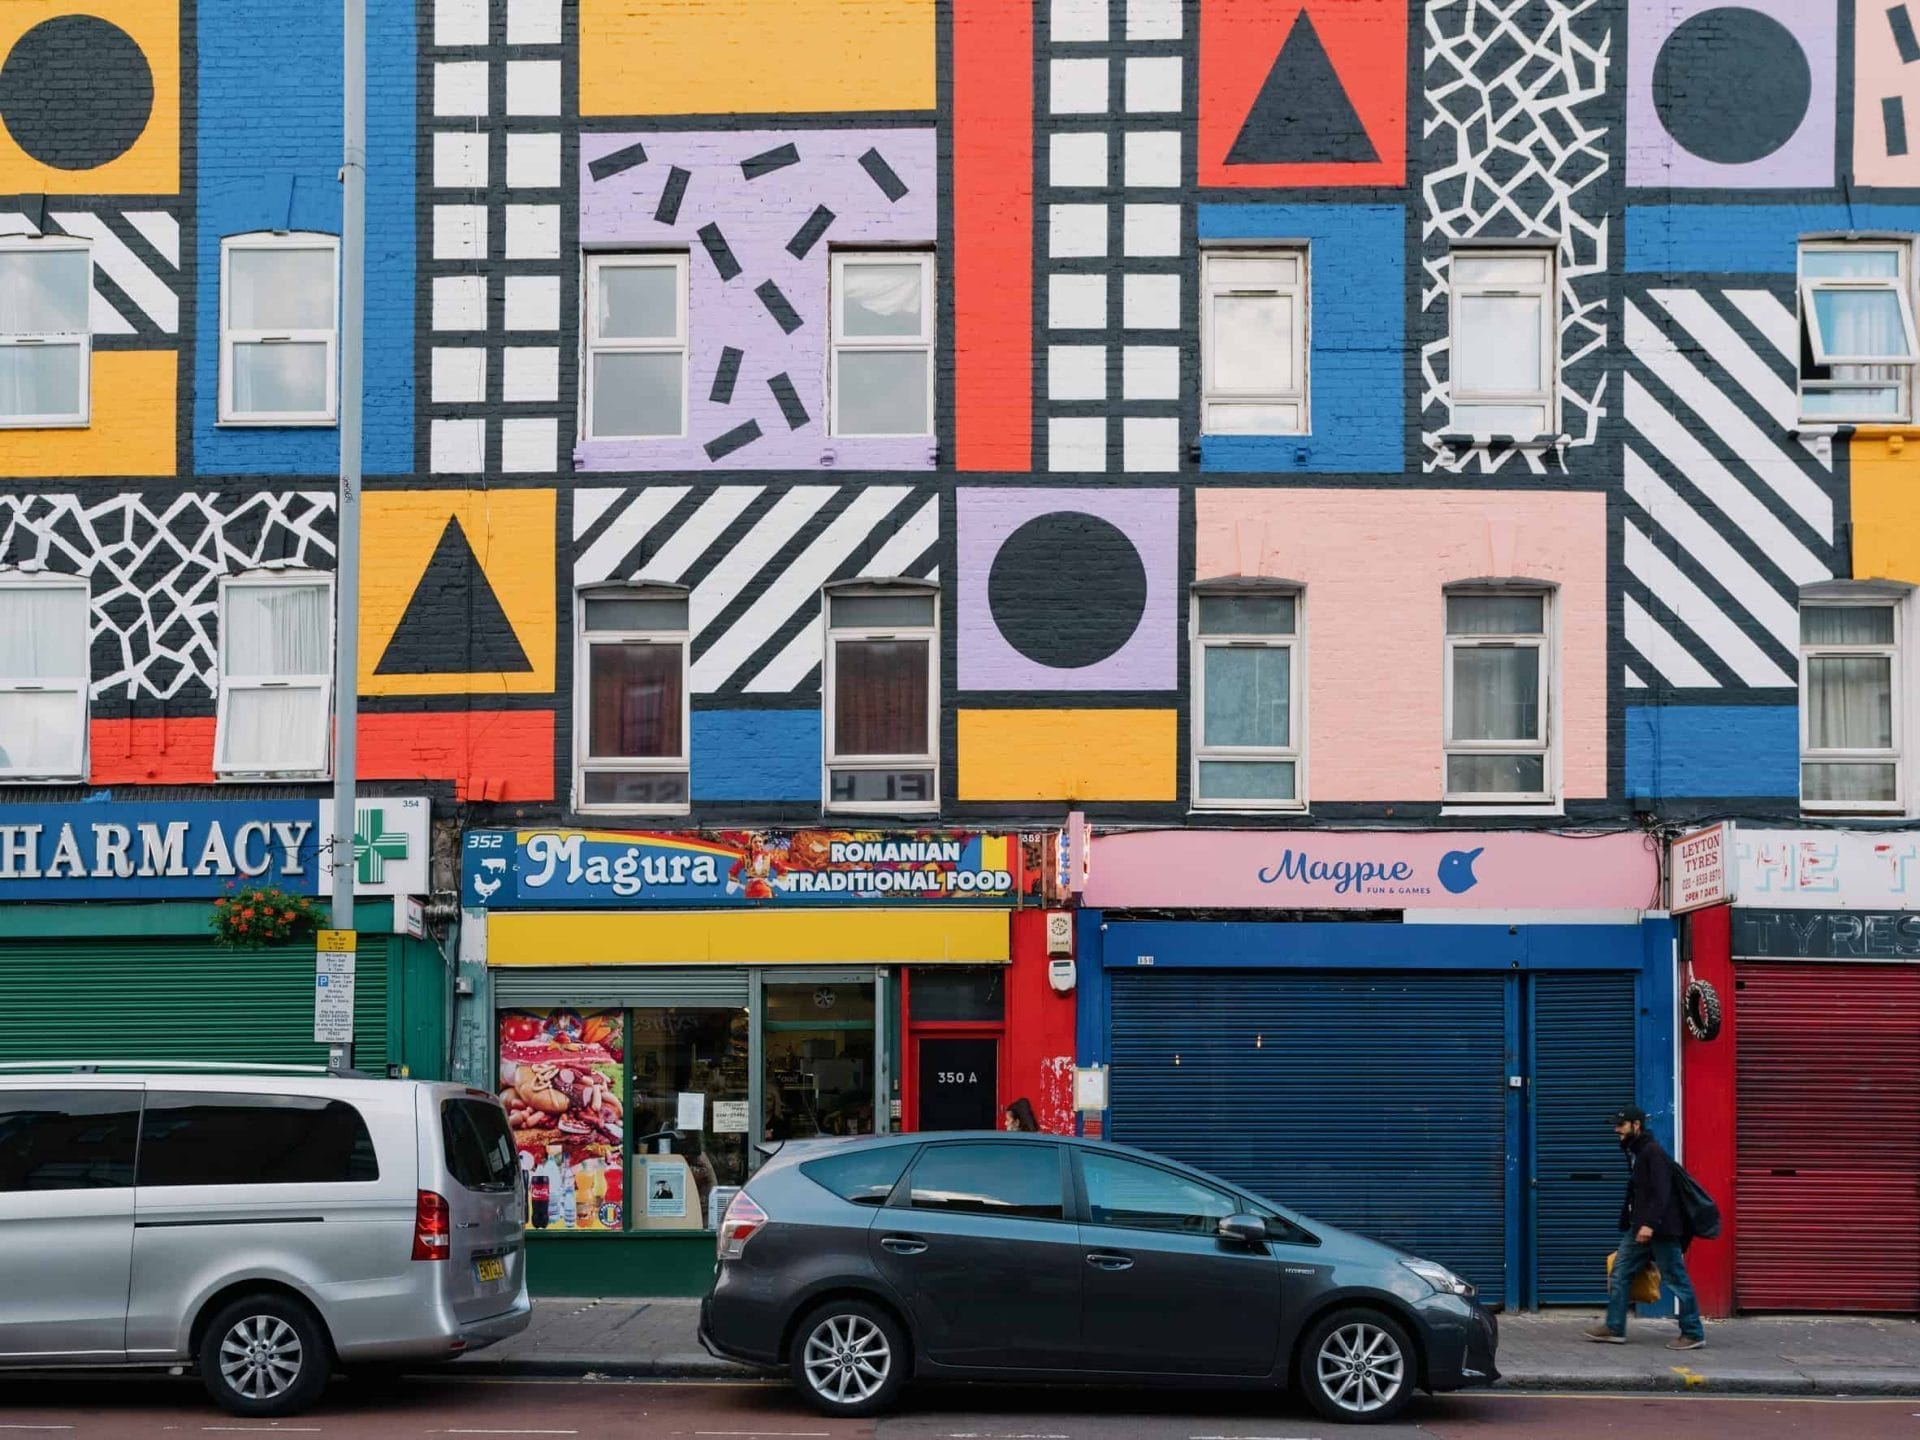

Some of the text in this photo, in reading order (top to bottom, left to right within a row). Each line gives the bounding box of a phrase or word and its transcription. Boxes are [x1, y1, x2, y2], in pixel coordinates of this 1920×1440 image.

[402, 800, 419, 808] 354
[0, 820, 313, 879] HARMACY
[467, 835, 504, 849] 352
[830, 841, 962, 863] ROMANIAN
[1682, 833, 1720, 859] LEYTON
[524, 832, 718, 897] Magura
[1258, 848, 1414, 894] Magpie
[1685, 851, 1718, 873] TYRES
[787, 870, 1012, 892] TRADITIONAL FOOD
[1684, 891, 1698, 903] OPEN
[1704, 885, 1719, 898] DAYS
[1744, 912, 1920, 956] TYRES
[937, 1072, 978, 1084] 350 A
